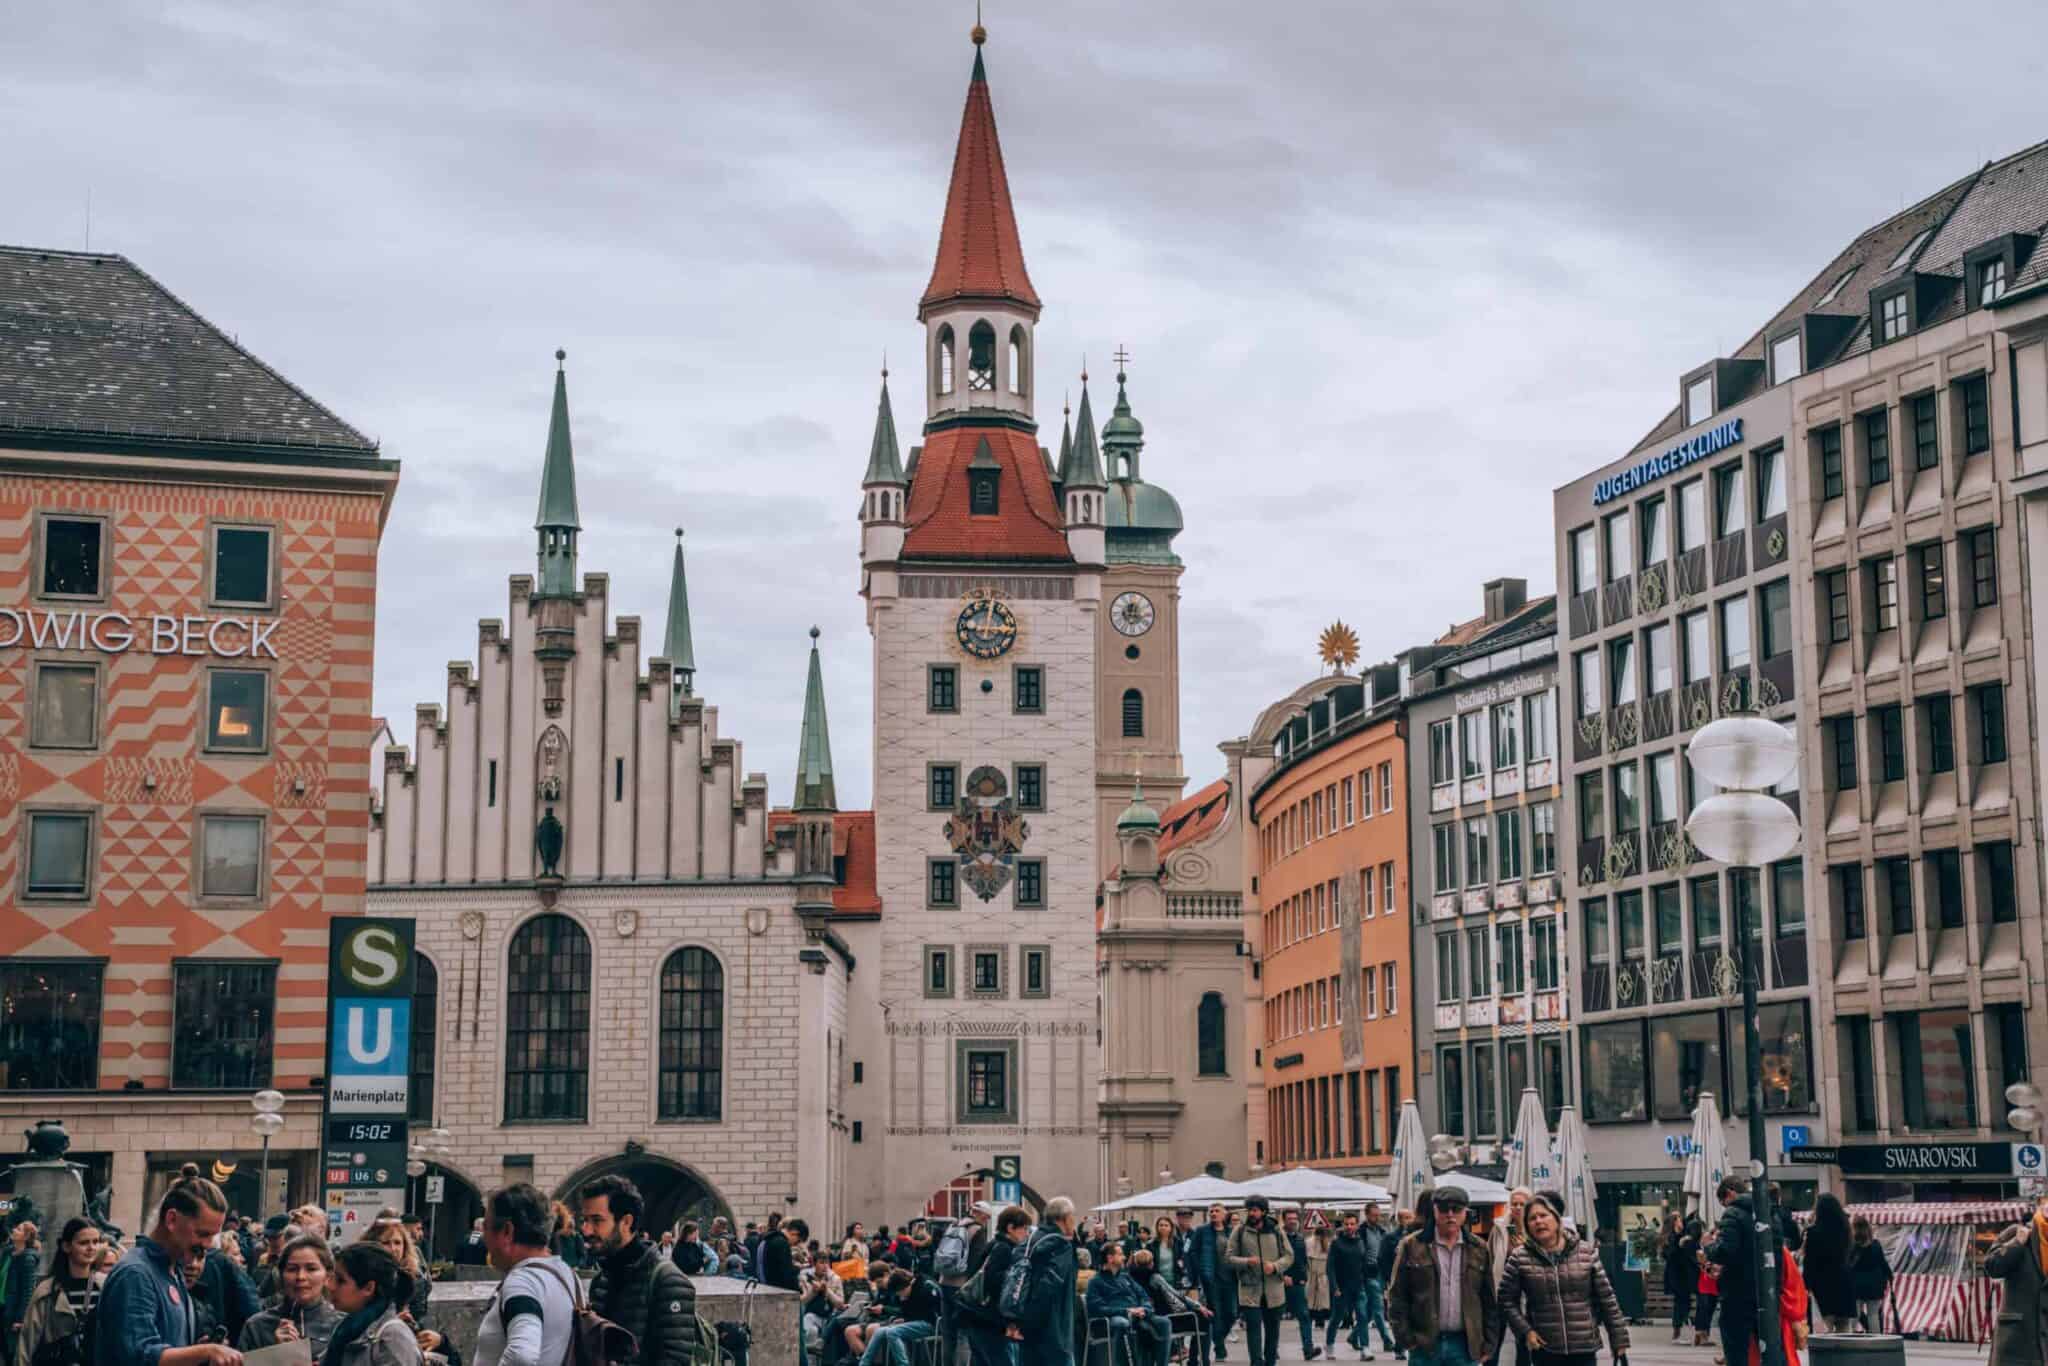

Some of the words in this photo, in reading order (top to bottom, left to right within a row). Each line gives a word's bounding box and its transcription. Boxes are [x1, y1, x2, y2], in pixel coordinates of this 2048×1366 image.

[1592, 417, 1744, 505] AUGENTAGESKLINIK
[152, 614, 280, 659] BECK
[351, 927, 398, 987] S
[347, 1007, 393, 1065] U
[332, 1088, 406, 1105] Marienplatz
[349, 1124, 391, 1139] 15:02
[1885, 1147, 1977, 1169] SWAROVSKI
[355, 1171, 370, 1181] U6
[1000, 1159, 1017, 1178] S
[1001, 1183, 1015, 1202] U
